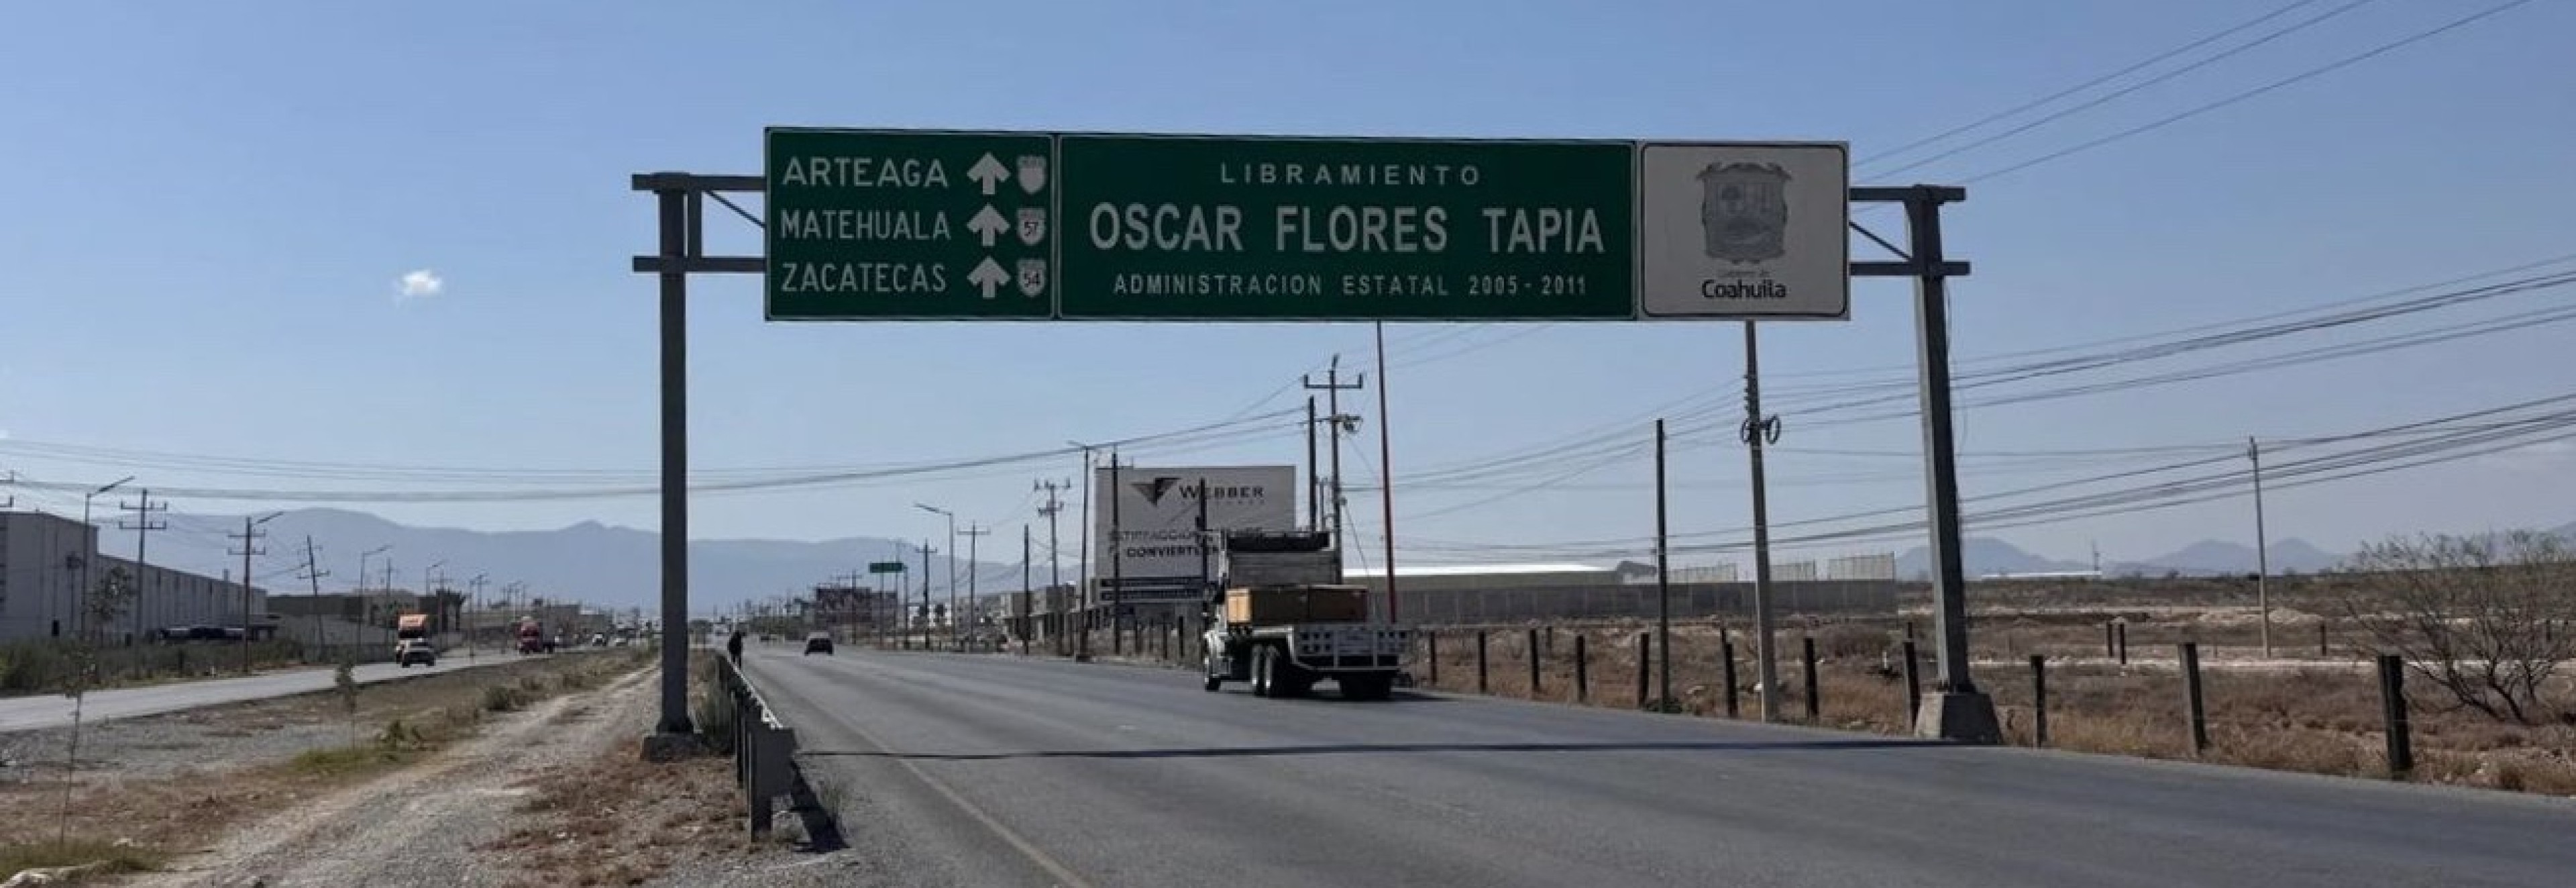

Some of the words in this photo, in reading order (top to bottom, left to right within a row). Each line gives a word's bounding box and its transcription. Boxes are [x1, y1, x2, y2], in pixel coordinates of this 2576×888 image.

[782, 156, 949, 188] ARTEAGA
[1221, 162, 1479, 186] LIBRAMIENTO
[780, 209, 952, 240] MATEHUALA
[1024, 221, 1039, 237] 57
[1089, 201, 1243, 251] OSCAR
[1277, 205, 1448, 253] FLORES
[1482, 207, 1605, 253] TAPIA
[781, 262, 947, 293] ZACATECAS
[1024, 273, 1040, 288] 54
[1113, 273, 1322, 295] ADMINISTRACION
[1342, 275, 1448, 297] ESTATAL
[1701, 279, 1787, 299] Coahuila
